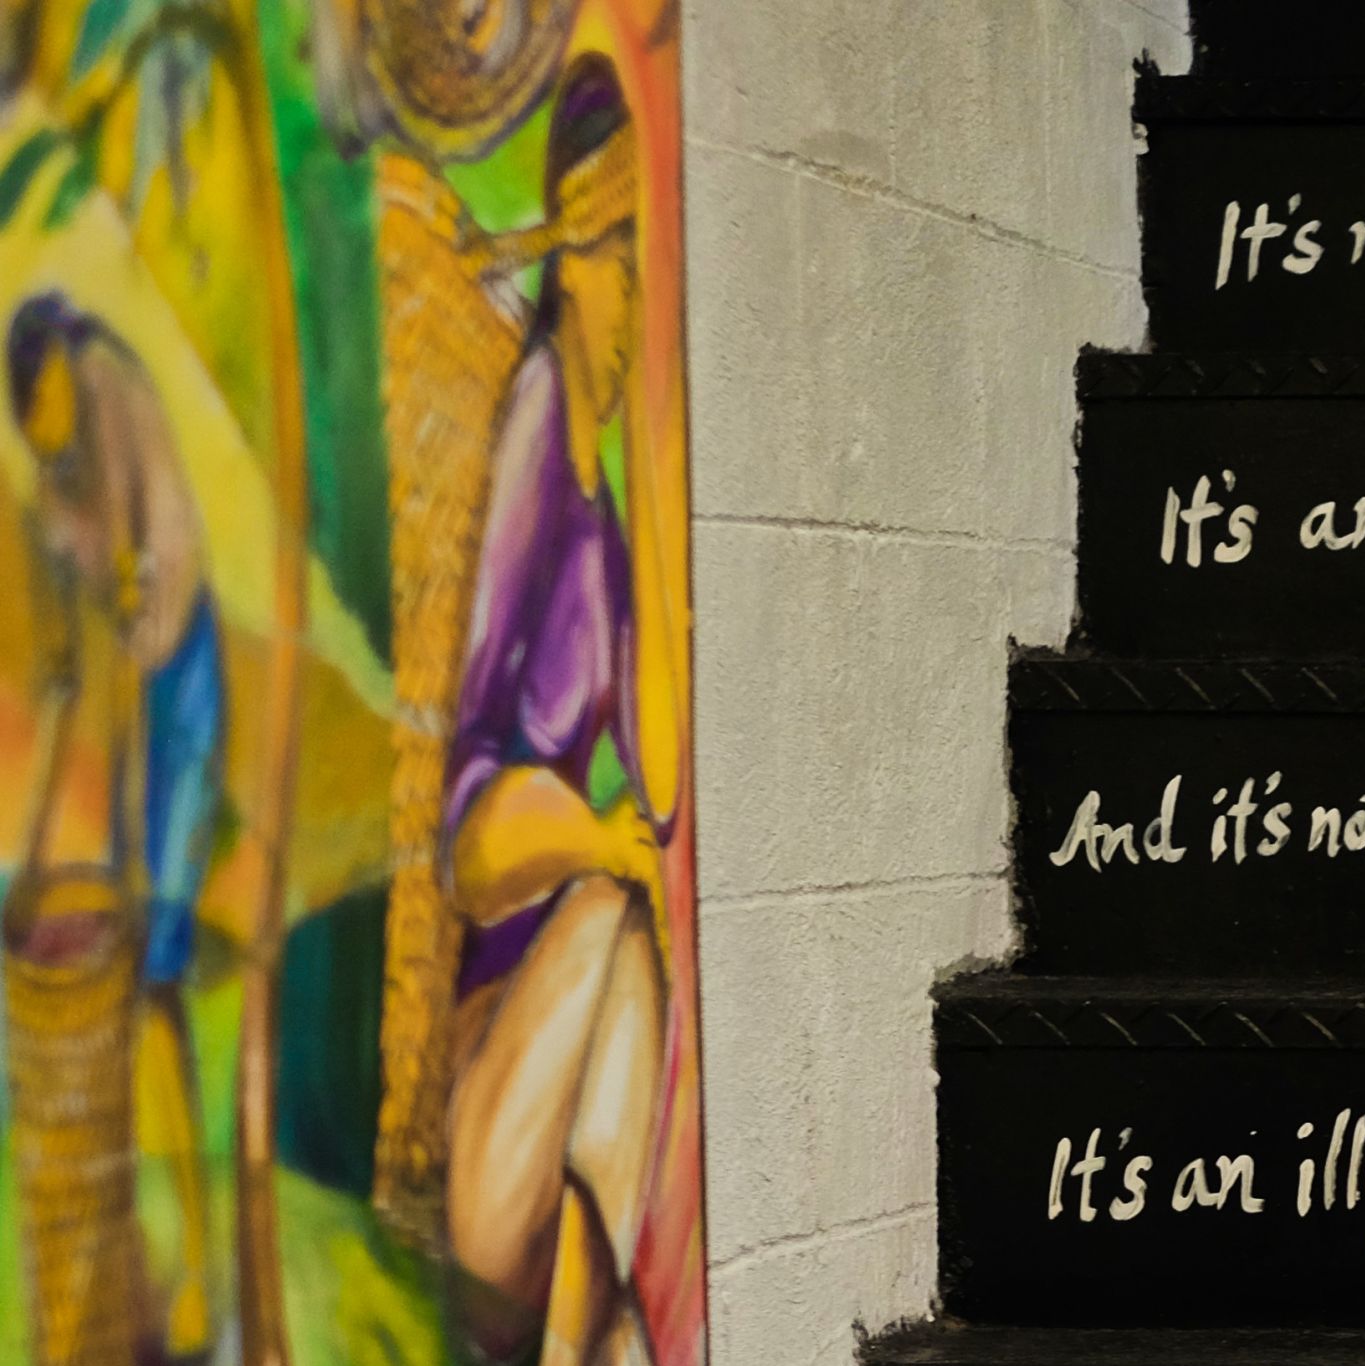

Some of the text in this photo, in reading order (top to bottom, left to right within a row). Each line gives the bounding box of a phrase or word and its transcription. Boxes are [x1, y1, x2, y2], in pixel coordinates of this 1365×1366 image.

[1215, 193, 1325, 290] It's
[1160, 469, 1260, 568] It's
[1048, 774, 1187, 874] And
[1211, 770, 1293, 866] it's
[1047, 1126, 1154, 1223] It's
[1171, 1153, 1266, 1214] an
